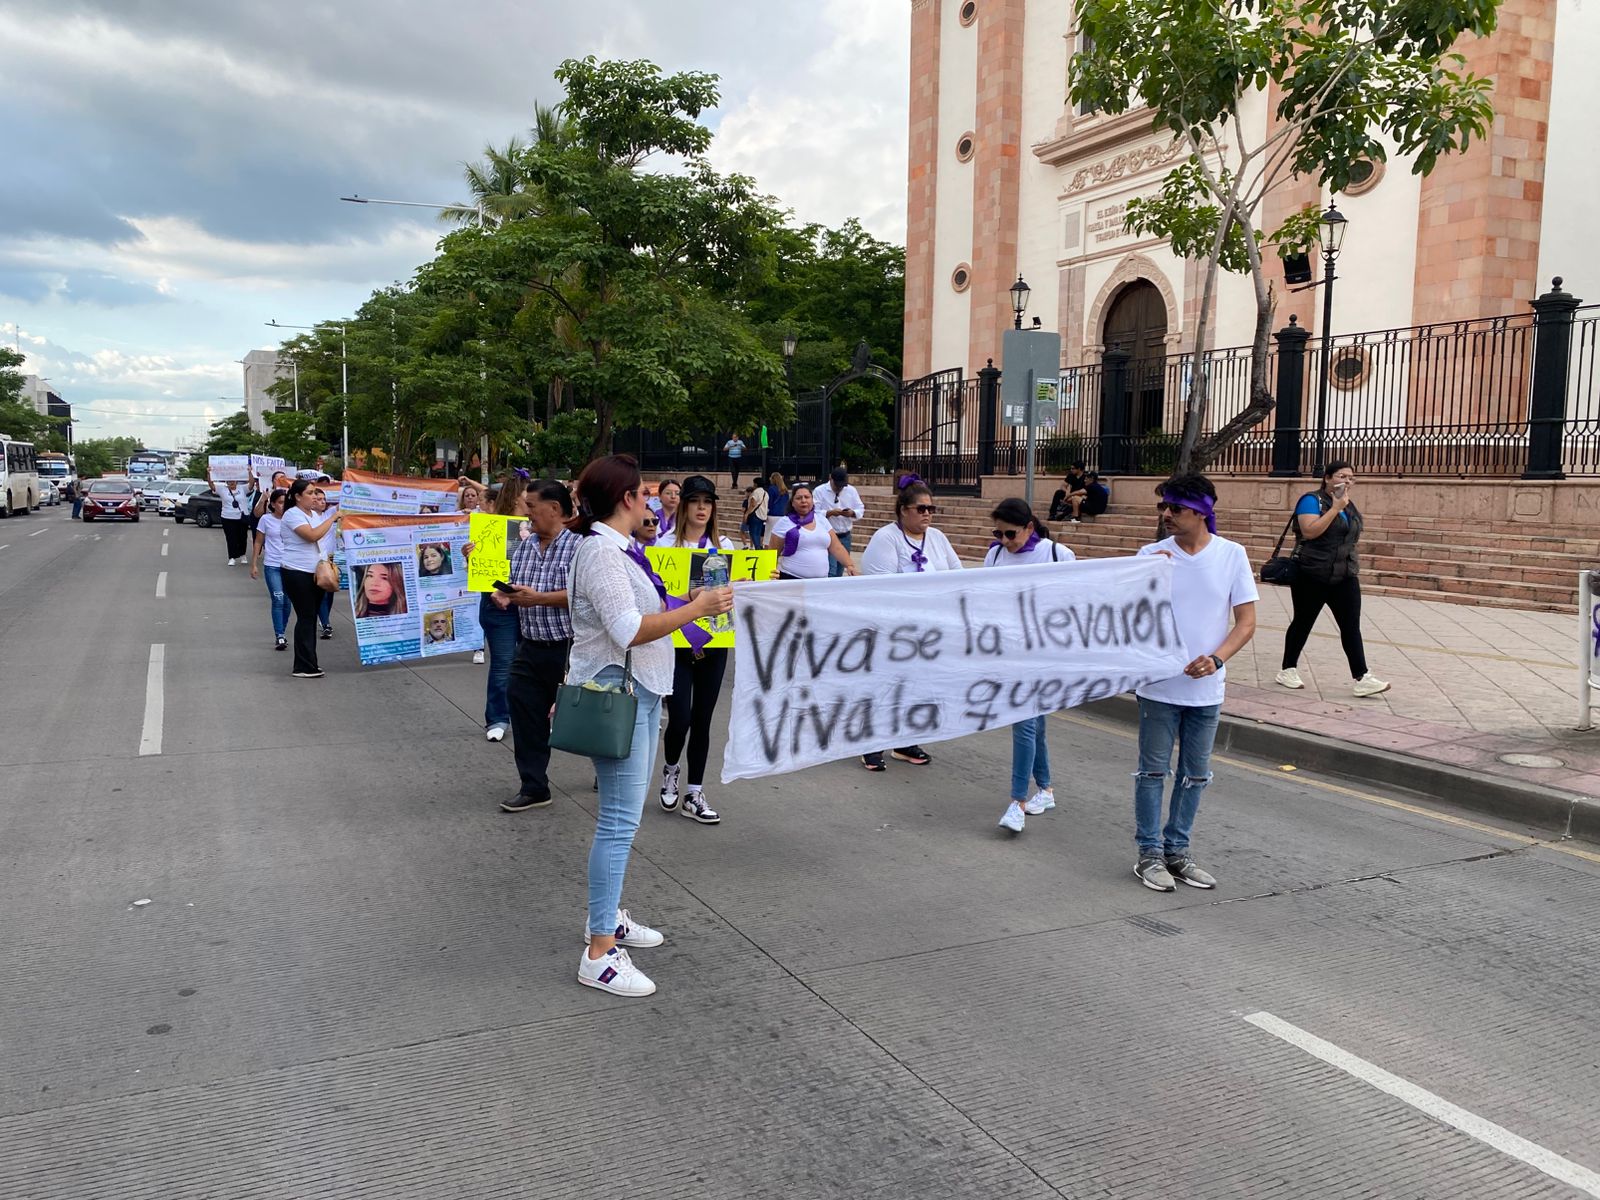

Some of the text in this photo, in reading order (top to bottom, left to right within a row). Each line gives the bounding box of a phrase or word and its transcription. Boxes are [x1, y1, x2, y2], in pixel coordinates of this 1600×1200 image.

[471, 557, 506, 568] GRITO
[471, 569, 498, 577] PARA
[656, 554, 677, 572] YA
[745, 556, 759, 581] 7
[743, 605, 878, 693] Viva
[888, 623, 943, 661] se
[959, 594, 1002, 655] la
[753, 686, 873, 765] Viva
[892, 676, 941, 735] la
